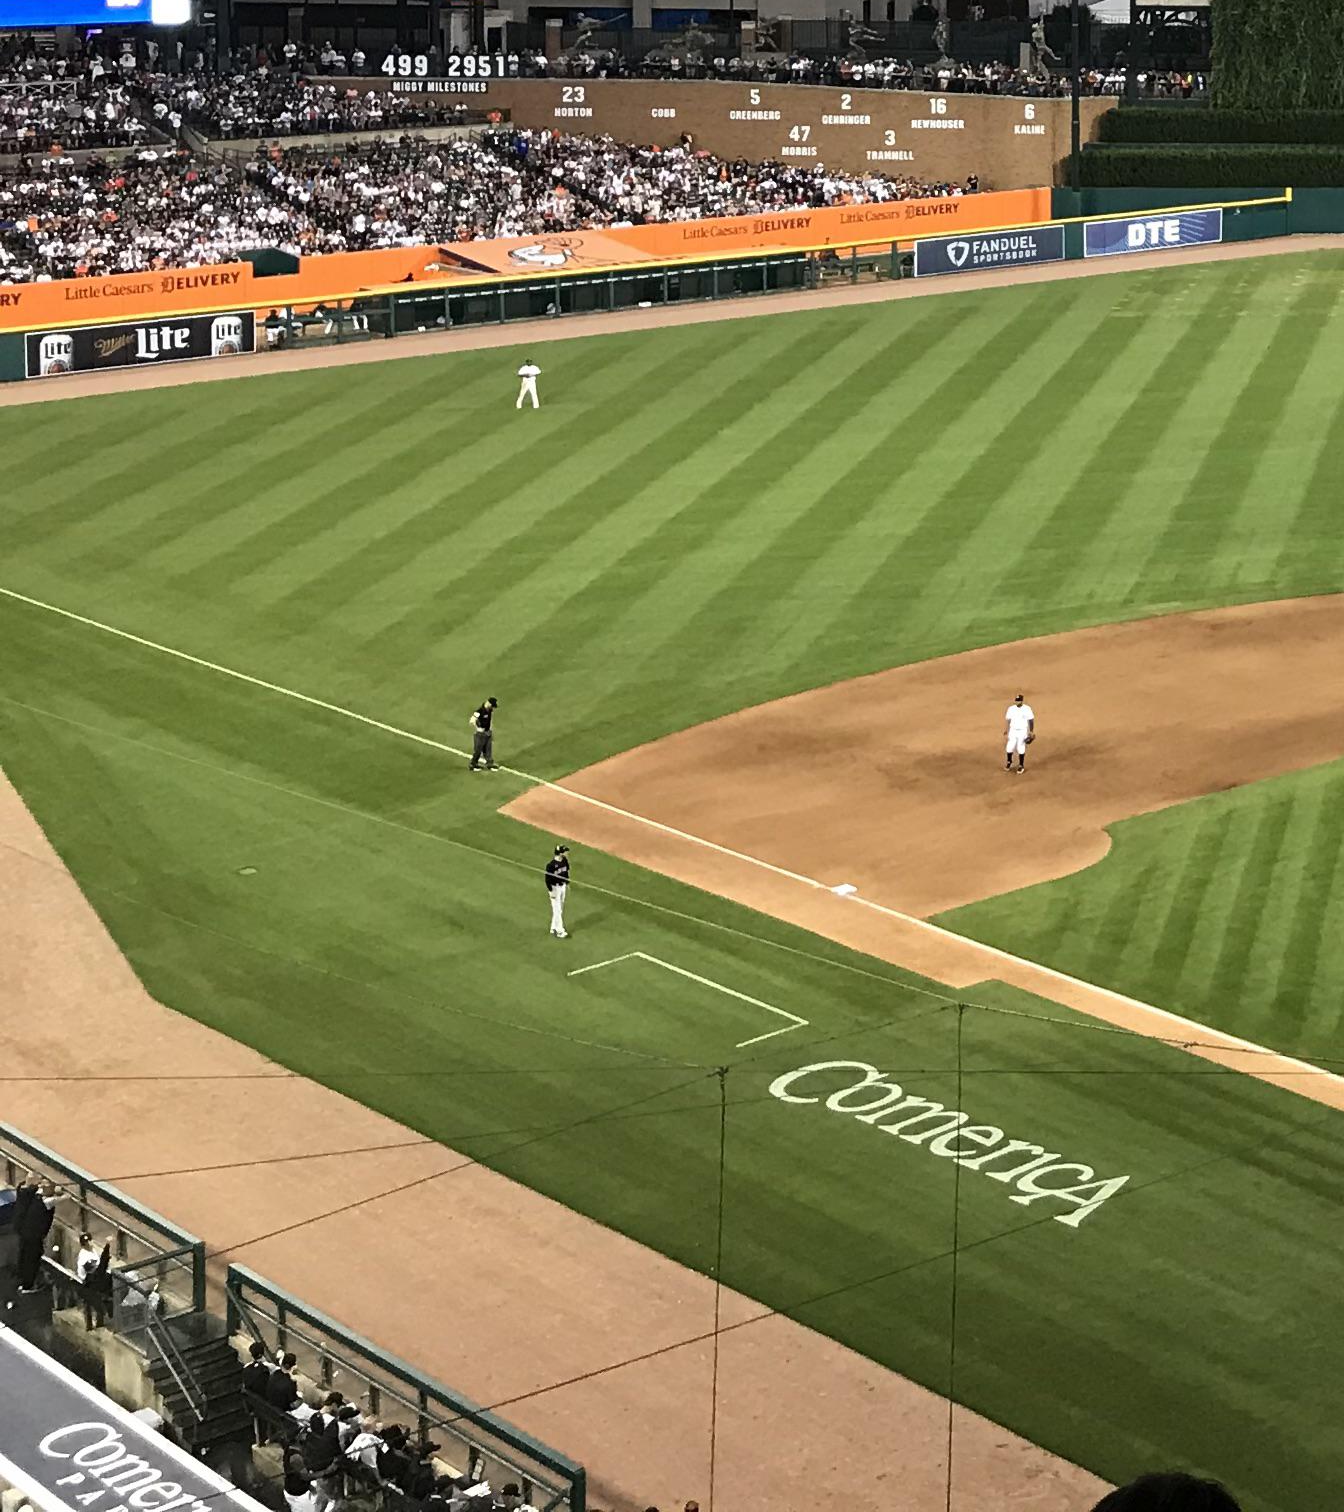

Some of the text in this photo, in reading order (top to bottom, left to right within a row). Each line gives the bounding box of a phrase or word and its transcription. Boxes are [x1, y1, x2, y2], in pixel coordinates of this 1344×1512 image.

[381, 54, 428, 76] 499
[448, 54, 505, 77] 2951
[427, 82, 487, 93] MILESTONES
[562, 86, 585, 103] 23
[750, 88, 761, 105] 5
[840, 93, 851, 110] 2
[929, 97, 947, 114] 16
[1024, 103, 1035, 120] 6
[789, 125, 811, 142] 47
[884, 130, 896, 146] 3
[865, 210, 900, 223] Caesars
[1127, 219, 1181, 248] DTE
[972, 235, 1037, 254] FANDUEL
[973, 249, 1038, 264] SPORTSBOOK
[65, 287, 100, 301] Little
[102, 280, 154, 298] Caesars
[135, 326, 191, 360] Lite
